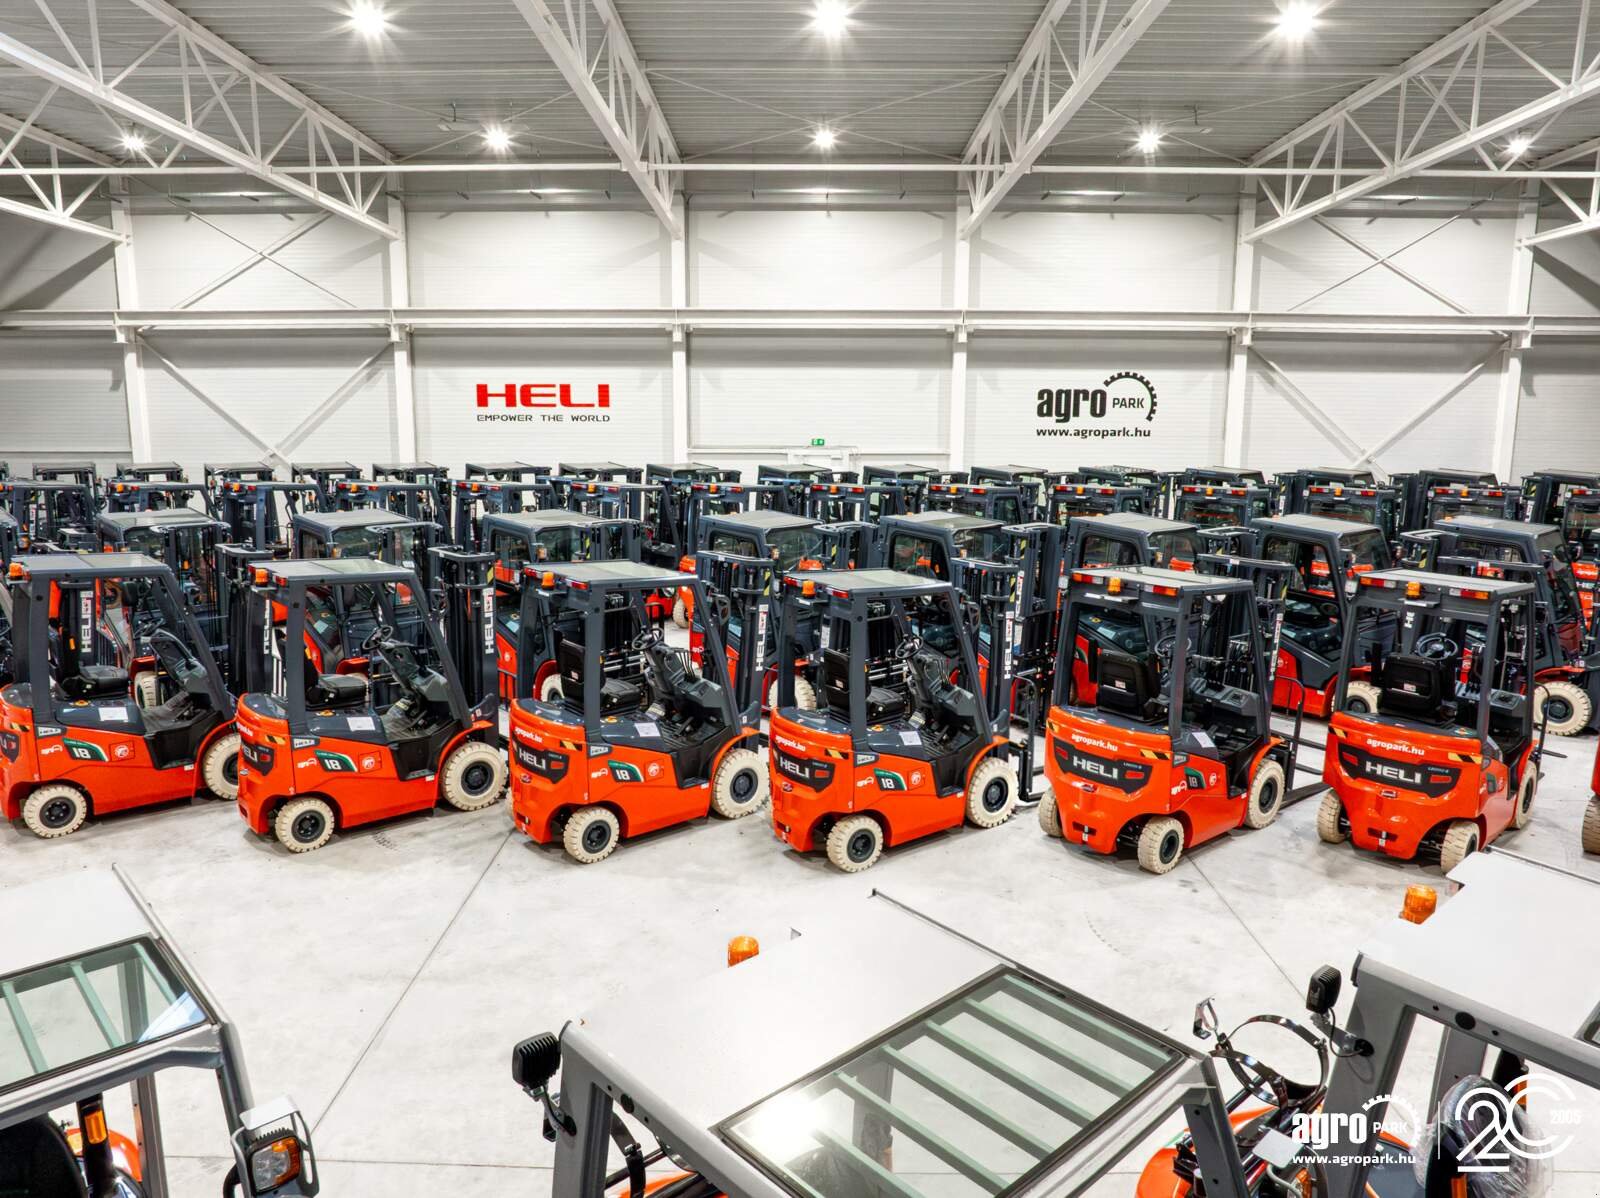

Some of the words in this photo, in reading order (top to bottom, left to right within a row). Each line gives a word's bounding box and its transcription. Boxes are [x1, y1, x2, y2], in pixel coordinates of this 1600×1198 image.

[476, 383, 610, 407] HELI
[1036, 388, 1107, 423] agro
[1112, 397, 1145, 409] PARK
[476, 414, 533, 422] EMPOWER
[540, 414, 564, 422] THE
[570, 414, 611, 422] WORLD
[1036, 427, 1151, 439] www.agropark.hu
[81, 614, 91, 653] HELI
[484, 611, 494, 654] HELI
[755, 630, 766, 671] HELI
[1004, 637, 1013, 679] HELI
[72, 747, 91, 759] 18
[1071, 734, 1118, 752] agropark.hu
[1366, 737, 1425, 756] agropark.hu
[324, 759, 342, 770] 18
[519, 749, 546, 770] HELI
[779, 756, 809, 778] HELI
[1072, 755, 1118, 779] HELI
[616, 769, 630, 781] 18
[1365, 760, 1421, 784] HELI
[880, 778, 895, 789] 18
